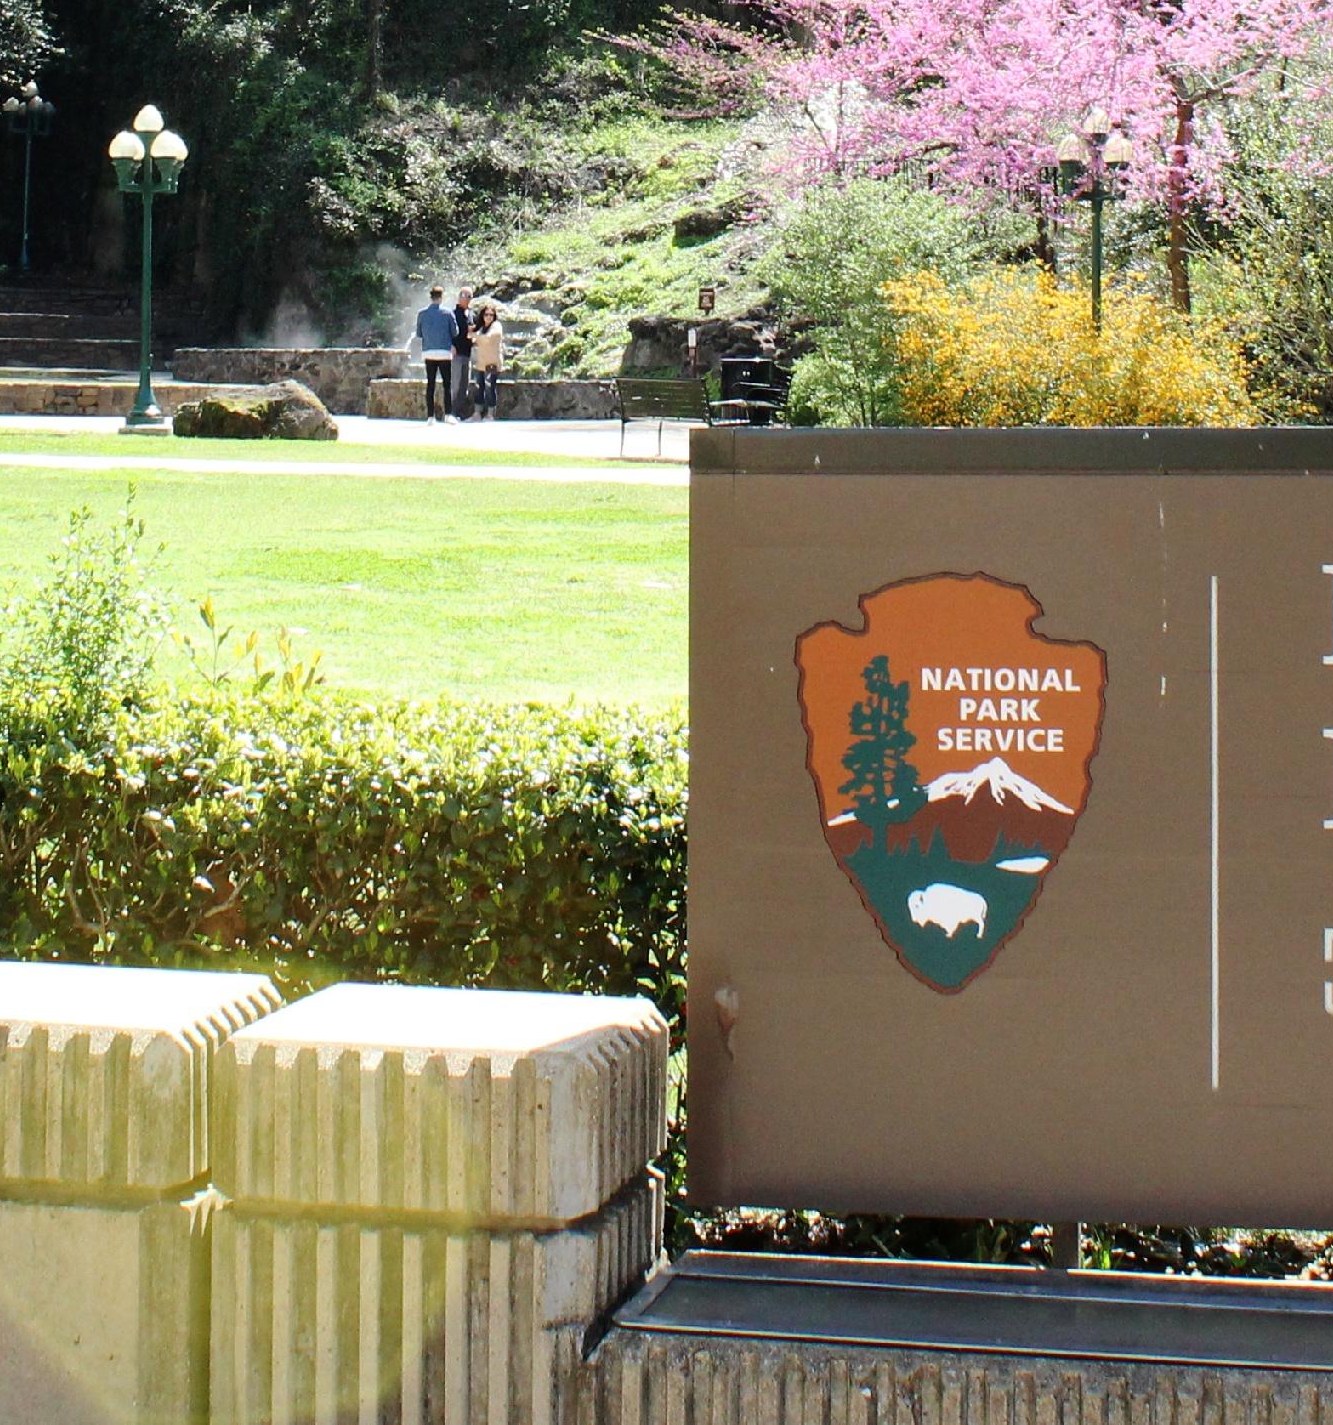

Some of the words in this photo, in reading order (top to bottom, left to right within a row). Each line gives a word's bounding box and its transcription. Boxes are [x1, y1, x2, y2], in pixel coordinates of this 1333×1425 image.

[921, 667, 1081, 692] NATIONAL
[960, 697, 1041, 721] PARK
[937, 727, 1064, 752] SERVICE
